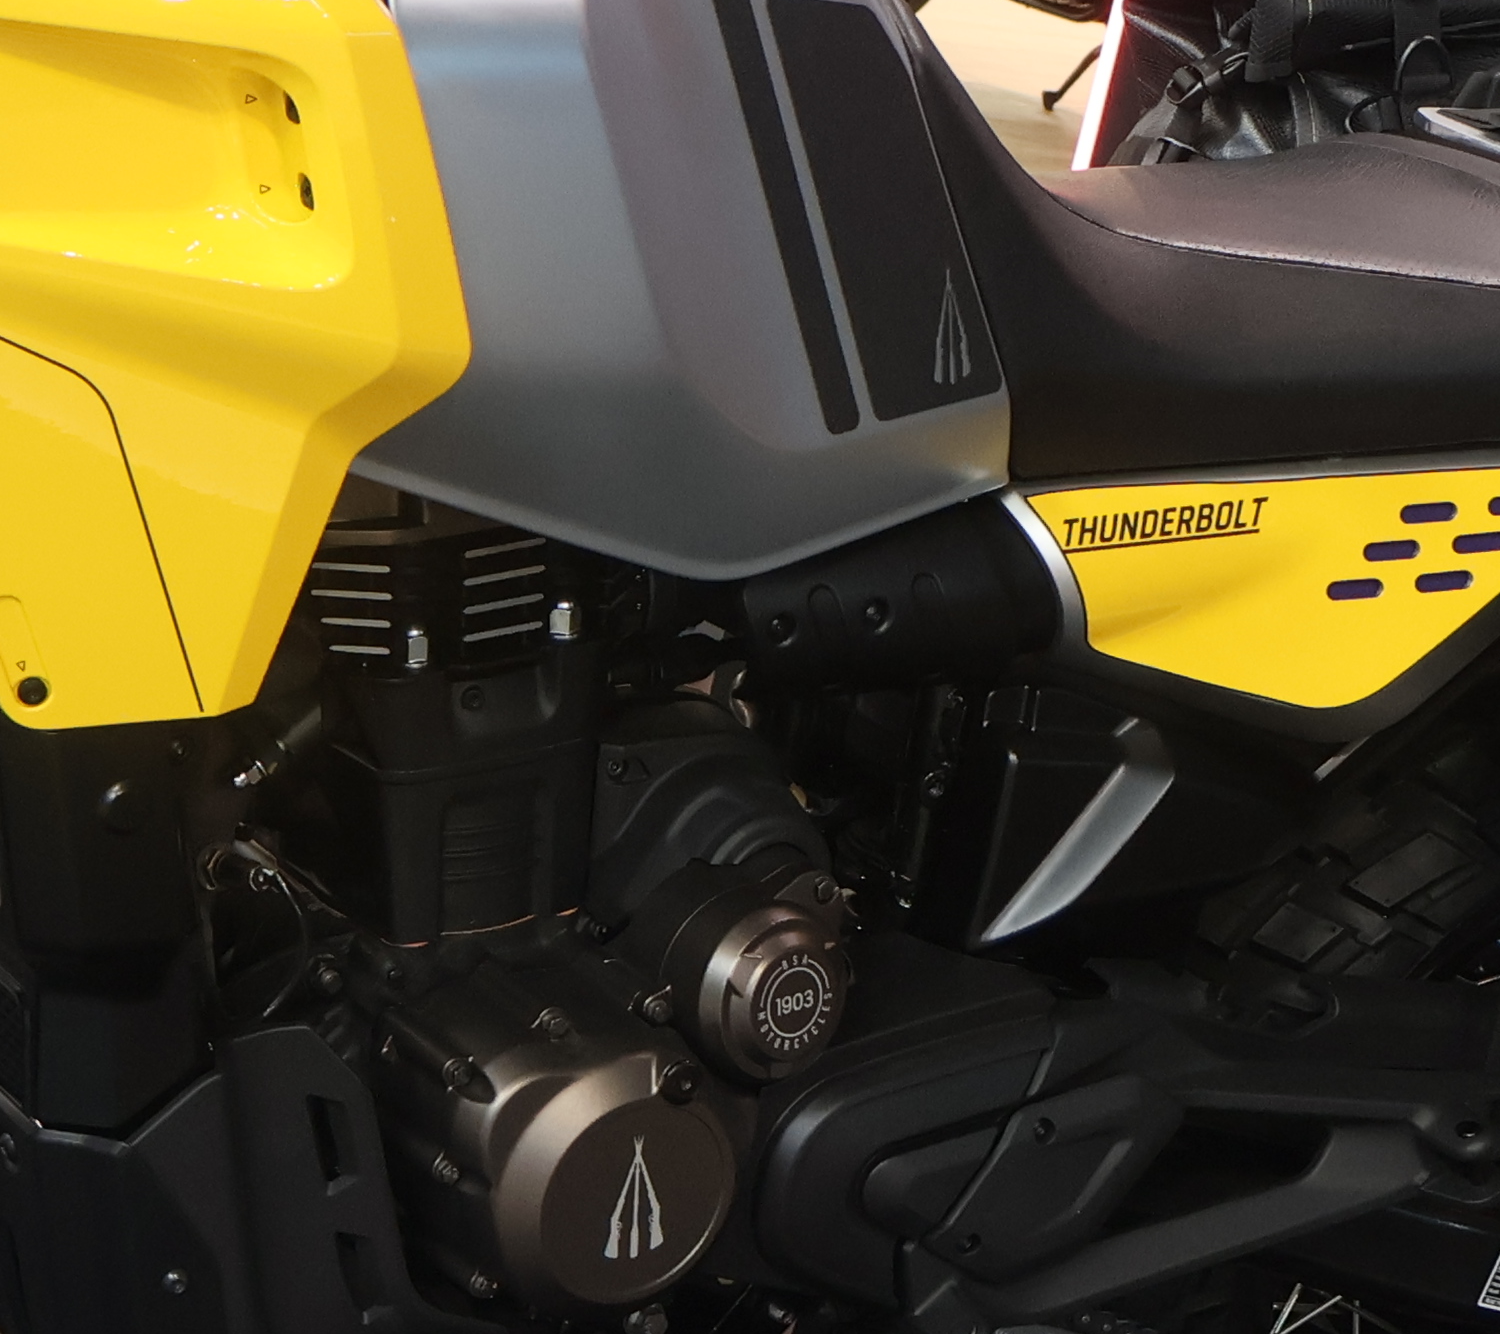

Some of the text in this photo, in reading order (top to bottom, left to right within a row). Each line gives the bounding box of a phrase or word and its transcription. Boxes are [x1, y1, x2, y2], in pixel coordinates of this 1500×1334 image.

[1062, 496, 1269, 548] THUNDERBOLT
[757, 992, 833, 1051] MOTORCYCLES
[775, 989, 814, 1017] 1903
